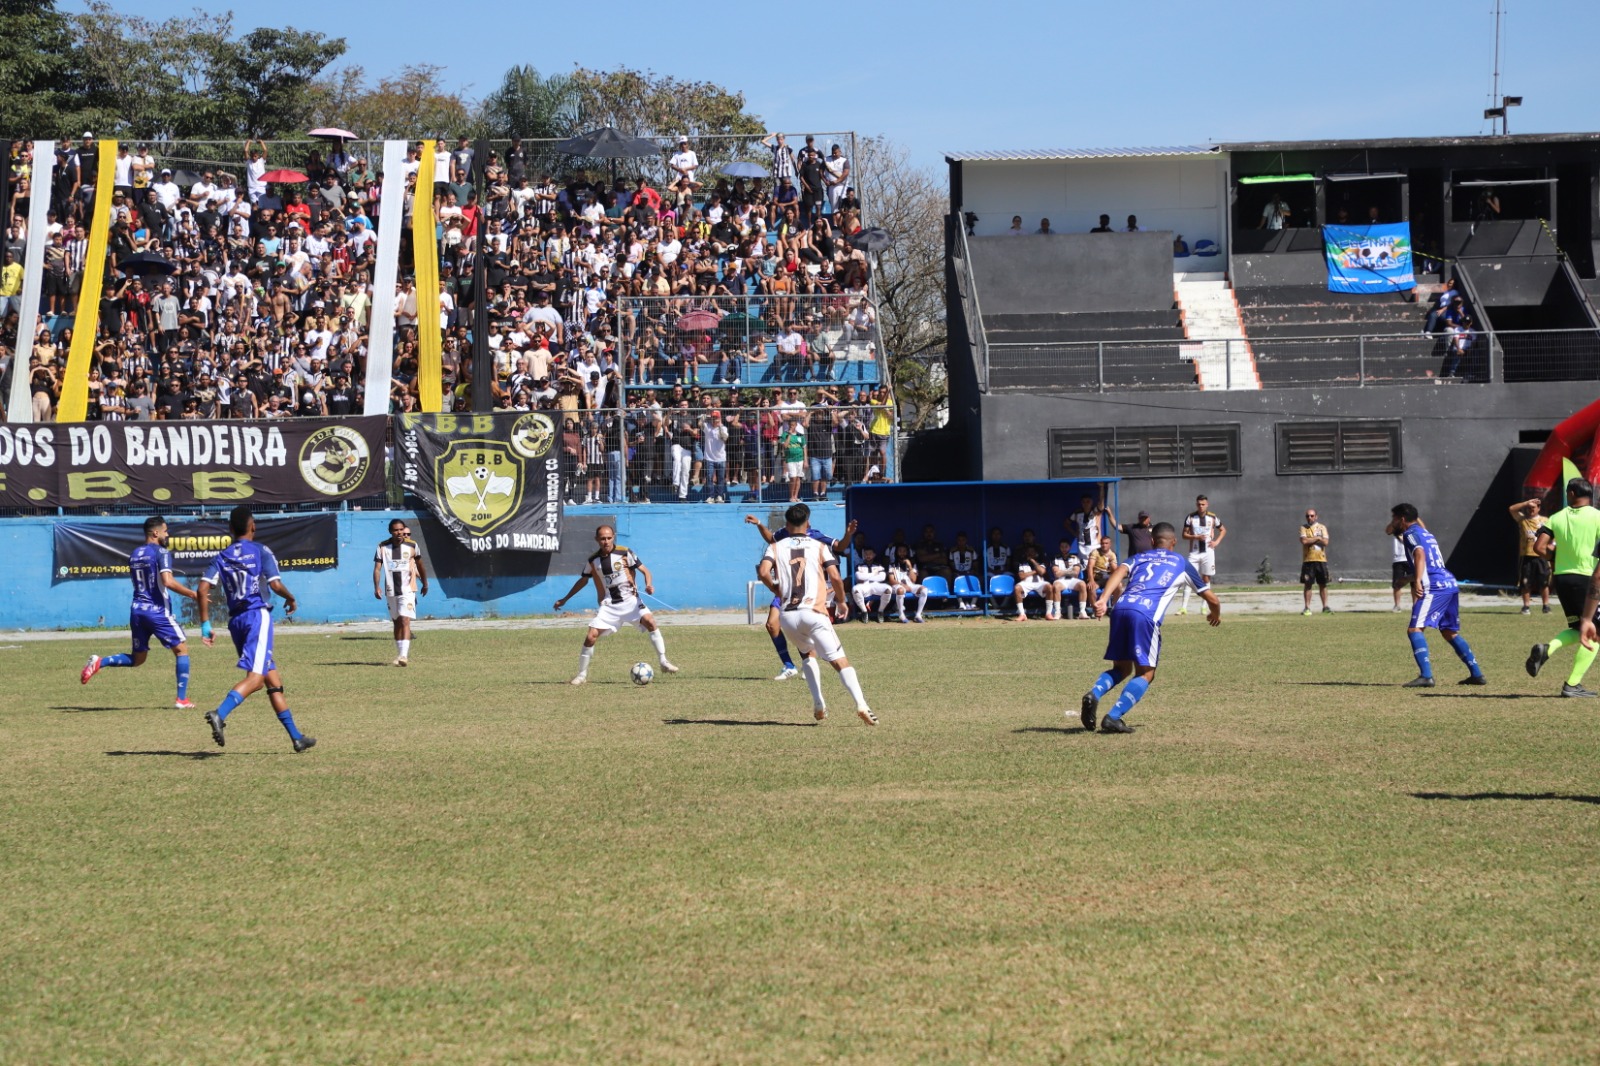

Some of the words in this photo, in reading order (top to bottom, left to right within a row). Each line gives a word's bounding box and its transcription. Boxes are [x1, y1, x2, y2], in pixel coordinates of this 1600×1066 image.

[68, 424, 112, 466] DO
[124, 425, 287, 466] BANDEIRA
[460, 453, 503, 465] F.B.B
[167, 535, 232, 551] JURUNA
[495, 533, 509, 549] DO
[513, 533, 560, 551] BANDEIRA
[68, 566, 79, 574] 12
[291, 557, 335, 566] 3354-6884
[136, 569, 146, 593] 9
[789, 557, 807, 587] 7
[1139, 562, 1162, 583] 5
[232, 570, 248, 600] 10
